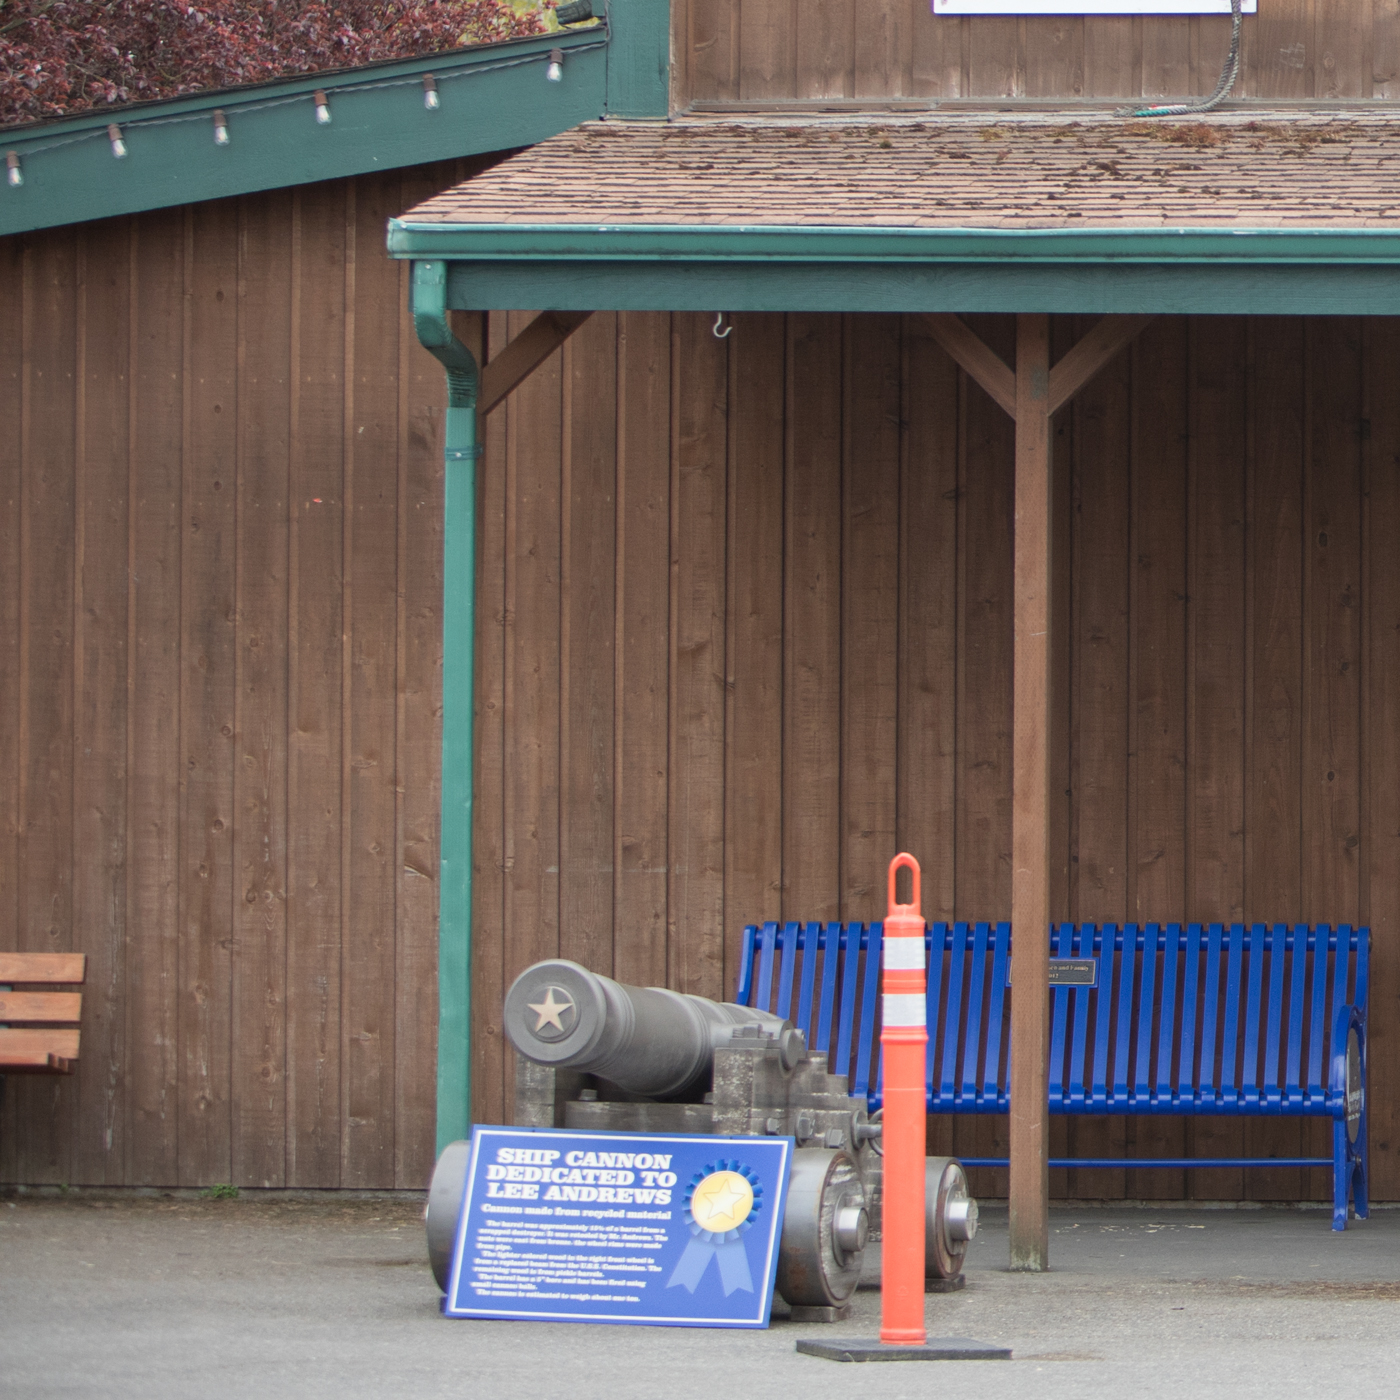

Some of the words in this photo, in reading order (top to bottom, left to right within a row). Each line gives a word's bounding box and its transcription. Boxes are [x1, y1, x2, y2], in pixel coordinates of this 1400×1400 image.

[497, 1148, 560, 1165] SHIP
[565, 1150, 672, 1170] CANNON
[486, 1164, 635, 1185] DEDICATED
[640, 1171, 678, 1187] TO
[486, 1182, 540, 1200] LEE
[543, 1185, 672, 1205] ANDREWS
[481, 1203, 522, 1214] Cannon
[525, 1205, 553, 1216] made
[555, 1206, 580, 1217] from
[582, 1208, 625, 1219] recycled
[626, 1210, 671, 1220] material
